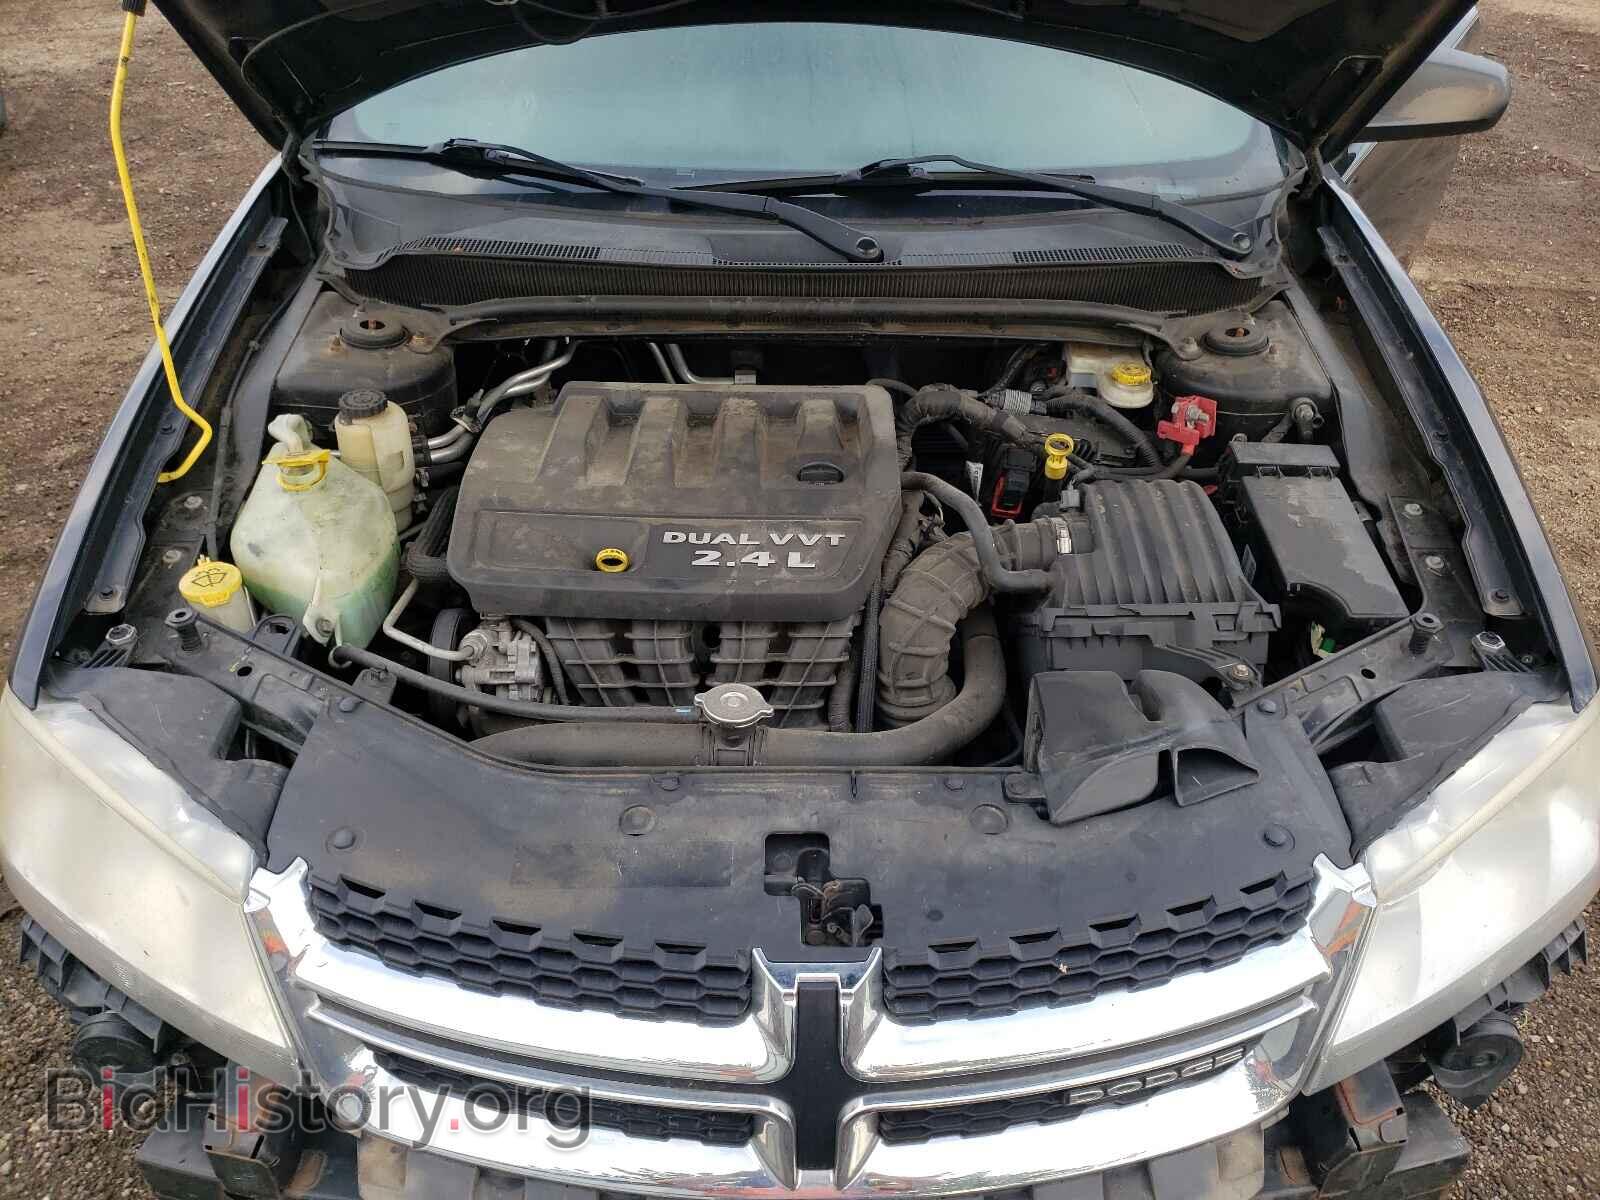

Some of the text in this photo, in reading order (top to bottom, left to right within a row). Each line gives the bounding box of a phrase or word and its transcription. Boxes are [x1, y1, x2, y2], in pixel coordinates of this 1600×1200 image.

[663, 531, 846, 547] DUAL VVT
[691, 550, 815, 568] 2.4 L
[1067, 1046, 1245, 1105] DODGE
